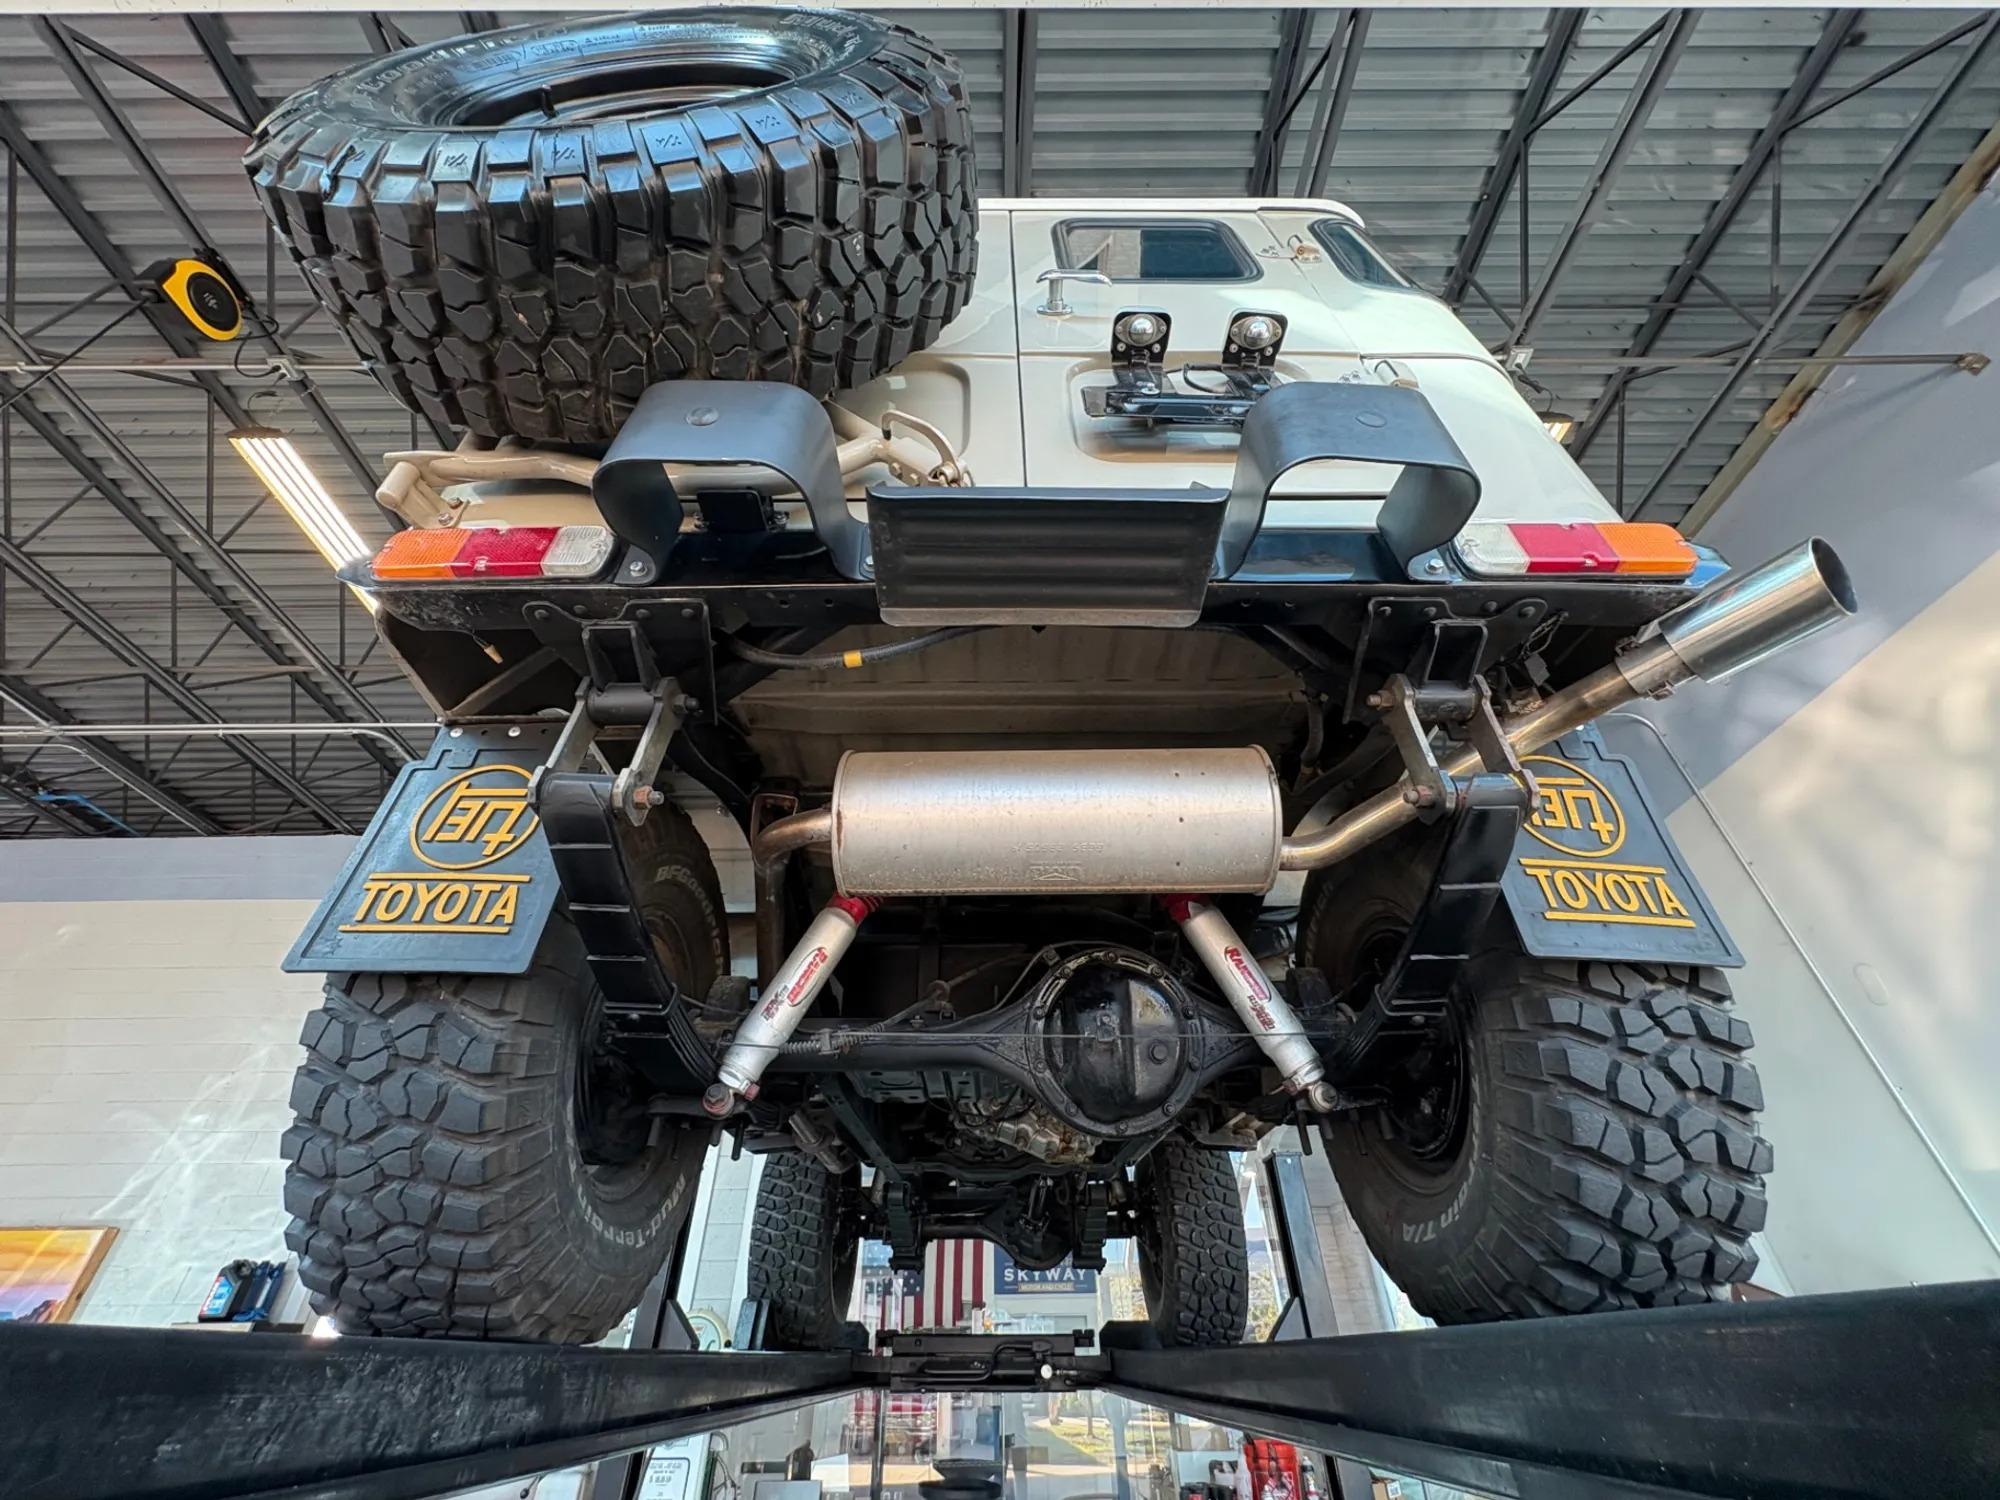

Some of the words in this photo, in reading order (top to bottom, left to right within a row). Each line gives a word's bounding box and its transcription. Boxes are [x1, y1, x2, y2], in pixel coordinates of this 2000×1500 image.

[354, 881, 520, 924] TOYOTA
[1525, 868, 1690, 917] TOYOTA
[577, 1173, 686, 1249] Mud-Terrain
[1402, 1219, 1437, 1244] T/A
[1004, 1268, 1086, 1281] SKYWAY
